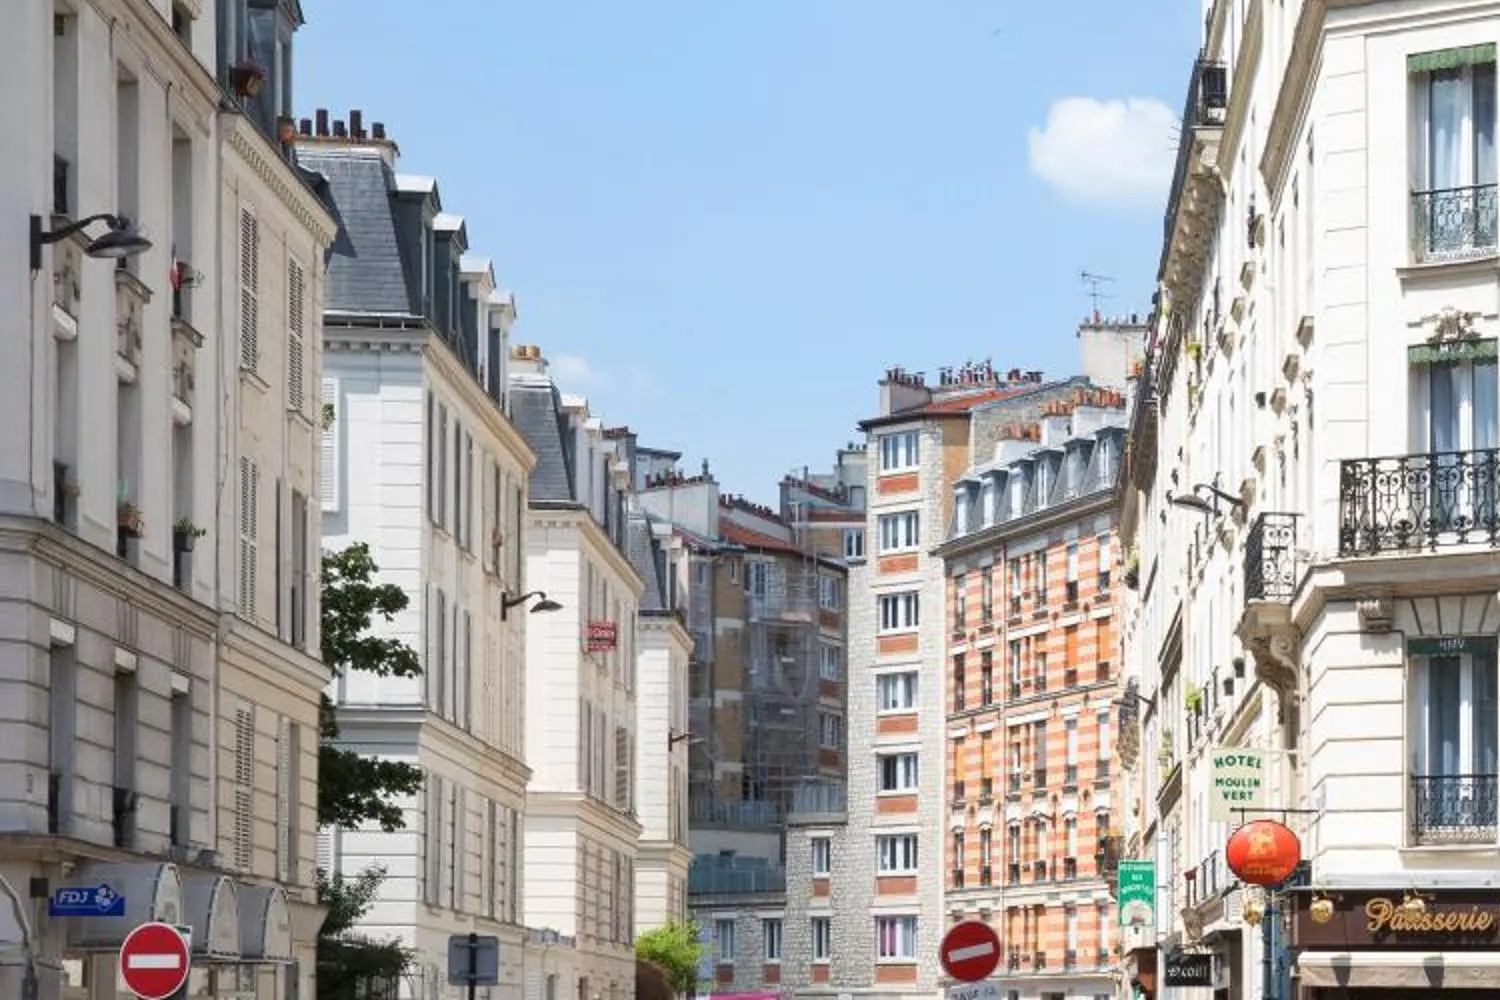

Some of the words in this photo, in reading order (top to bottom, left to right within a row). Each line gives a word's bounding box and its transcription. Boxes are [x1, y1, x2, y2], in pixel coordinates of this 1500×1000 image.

[1214, 755, 1261, 769] HOTEL
[1215, 778, 1261, 787] MOULIN
[1222, 791, 1253, 801] VERT
[59, 891, 89, 904] FDJ
